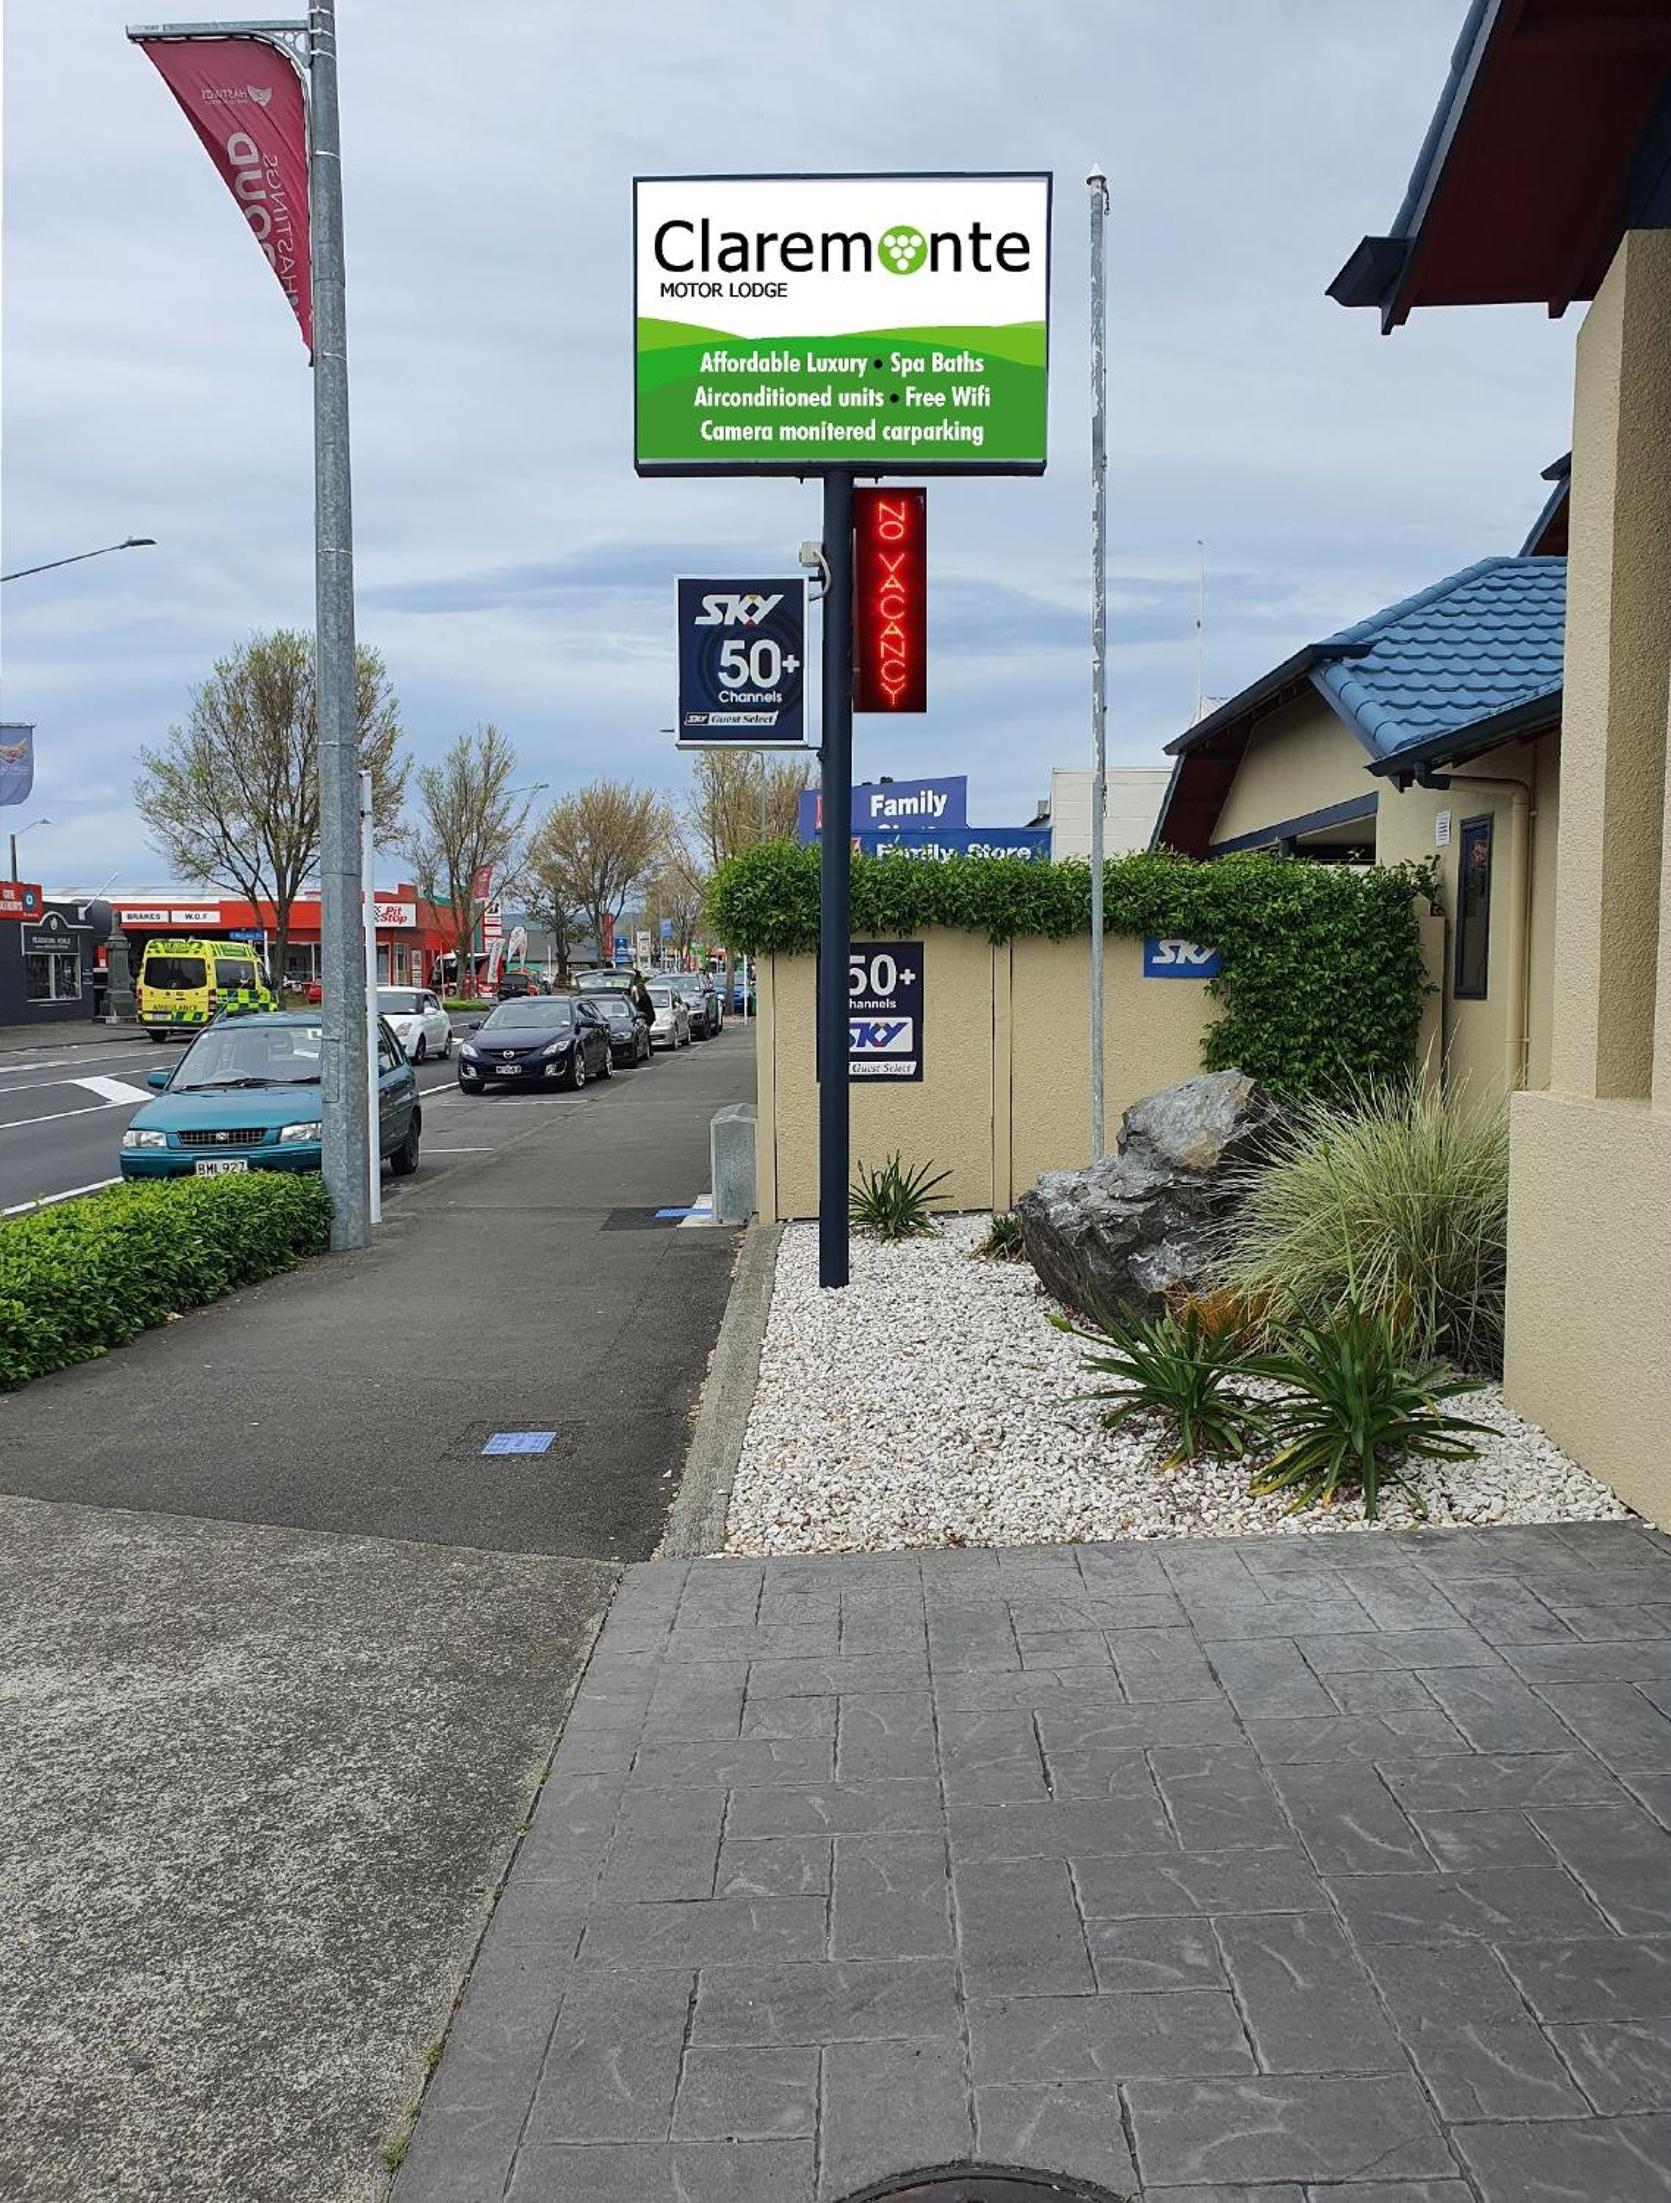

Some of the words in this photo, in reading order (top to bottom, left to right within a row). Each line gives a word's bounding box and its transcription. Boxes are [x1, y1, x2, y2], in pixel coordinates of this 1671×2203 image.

[660, 282, 723, 298] MOTOR
[729, 282, 788, 298] LODGE
[700, 352, 800, 373] Affordable
[807, 352, 868, 377] Luxury
[890, 352, 924, 377] Spa
[932, 351, 984, 373] Baths
[694, 386, 832, 407] Airconditioned
[838, 386, 884, 407] units
[905, 386, 945, 406] Free
[951, 386, 991, 407] Wifi
[700, 420, 772, 441] Camera
[779, 420, 876, 441] monitered
[883, 420, 984, 446] carparking
[878, 502, 906, 540] NO
[694, 593, 785, 627] SKY
[878, 552, 907, 706] VACANCY
[717, 638, 801, 689] 50+
[718, 690, 783, 704] Channels
[710, 713, 742, 724] Guest
[743, 713, 774, 724] Select
[870, 790, 948, 818] Family
[380, 913, 408, 925] Stop
[385, 905, 402, 915] Pit
[850, 998, 897, 1009] hannels
[852, 1063, 880, 1074] Guest
[883, 1062, 912, 1074] Select
